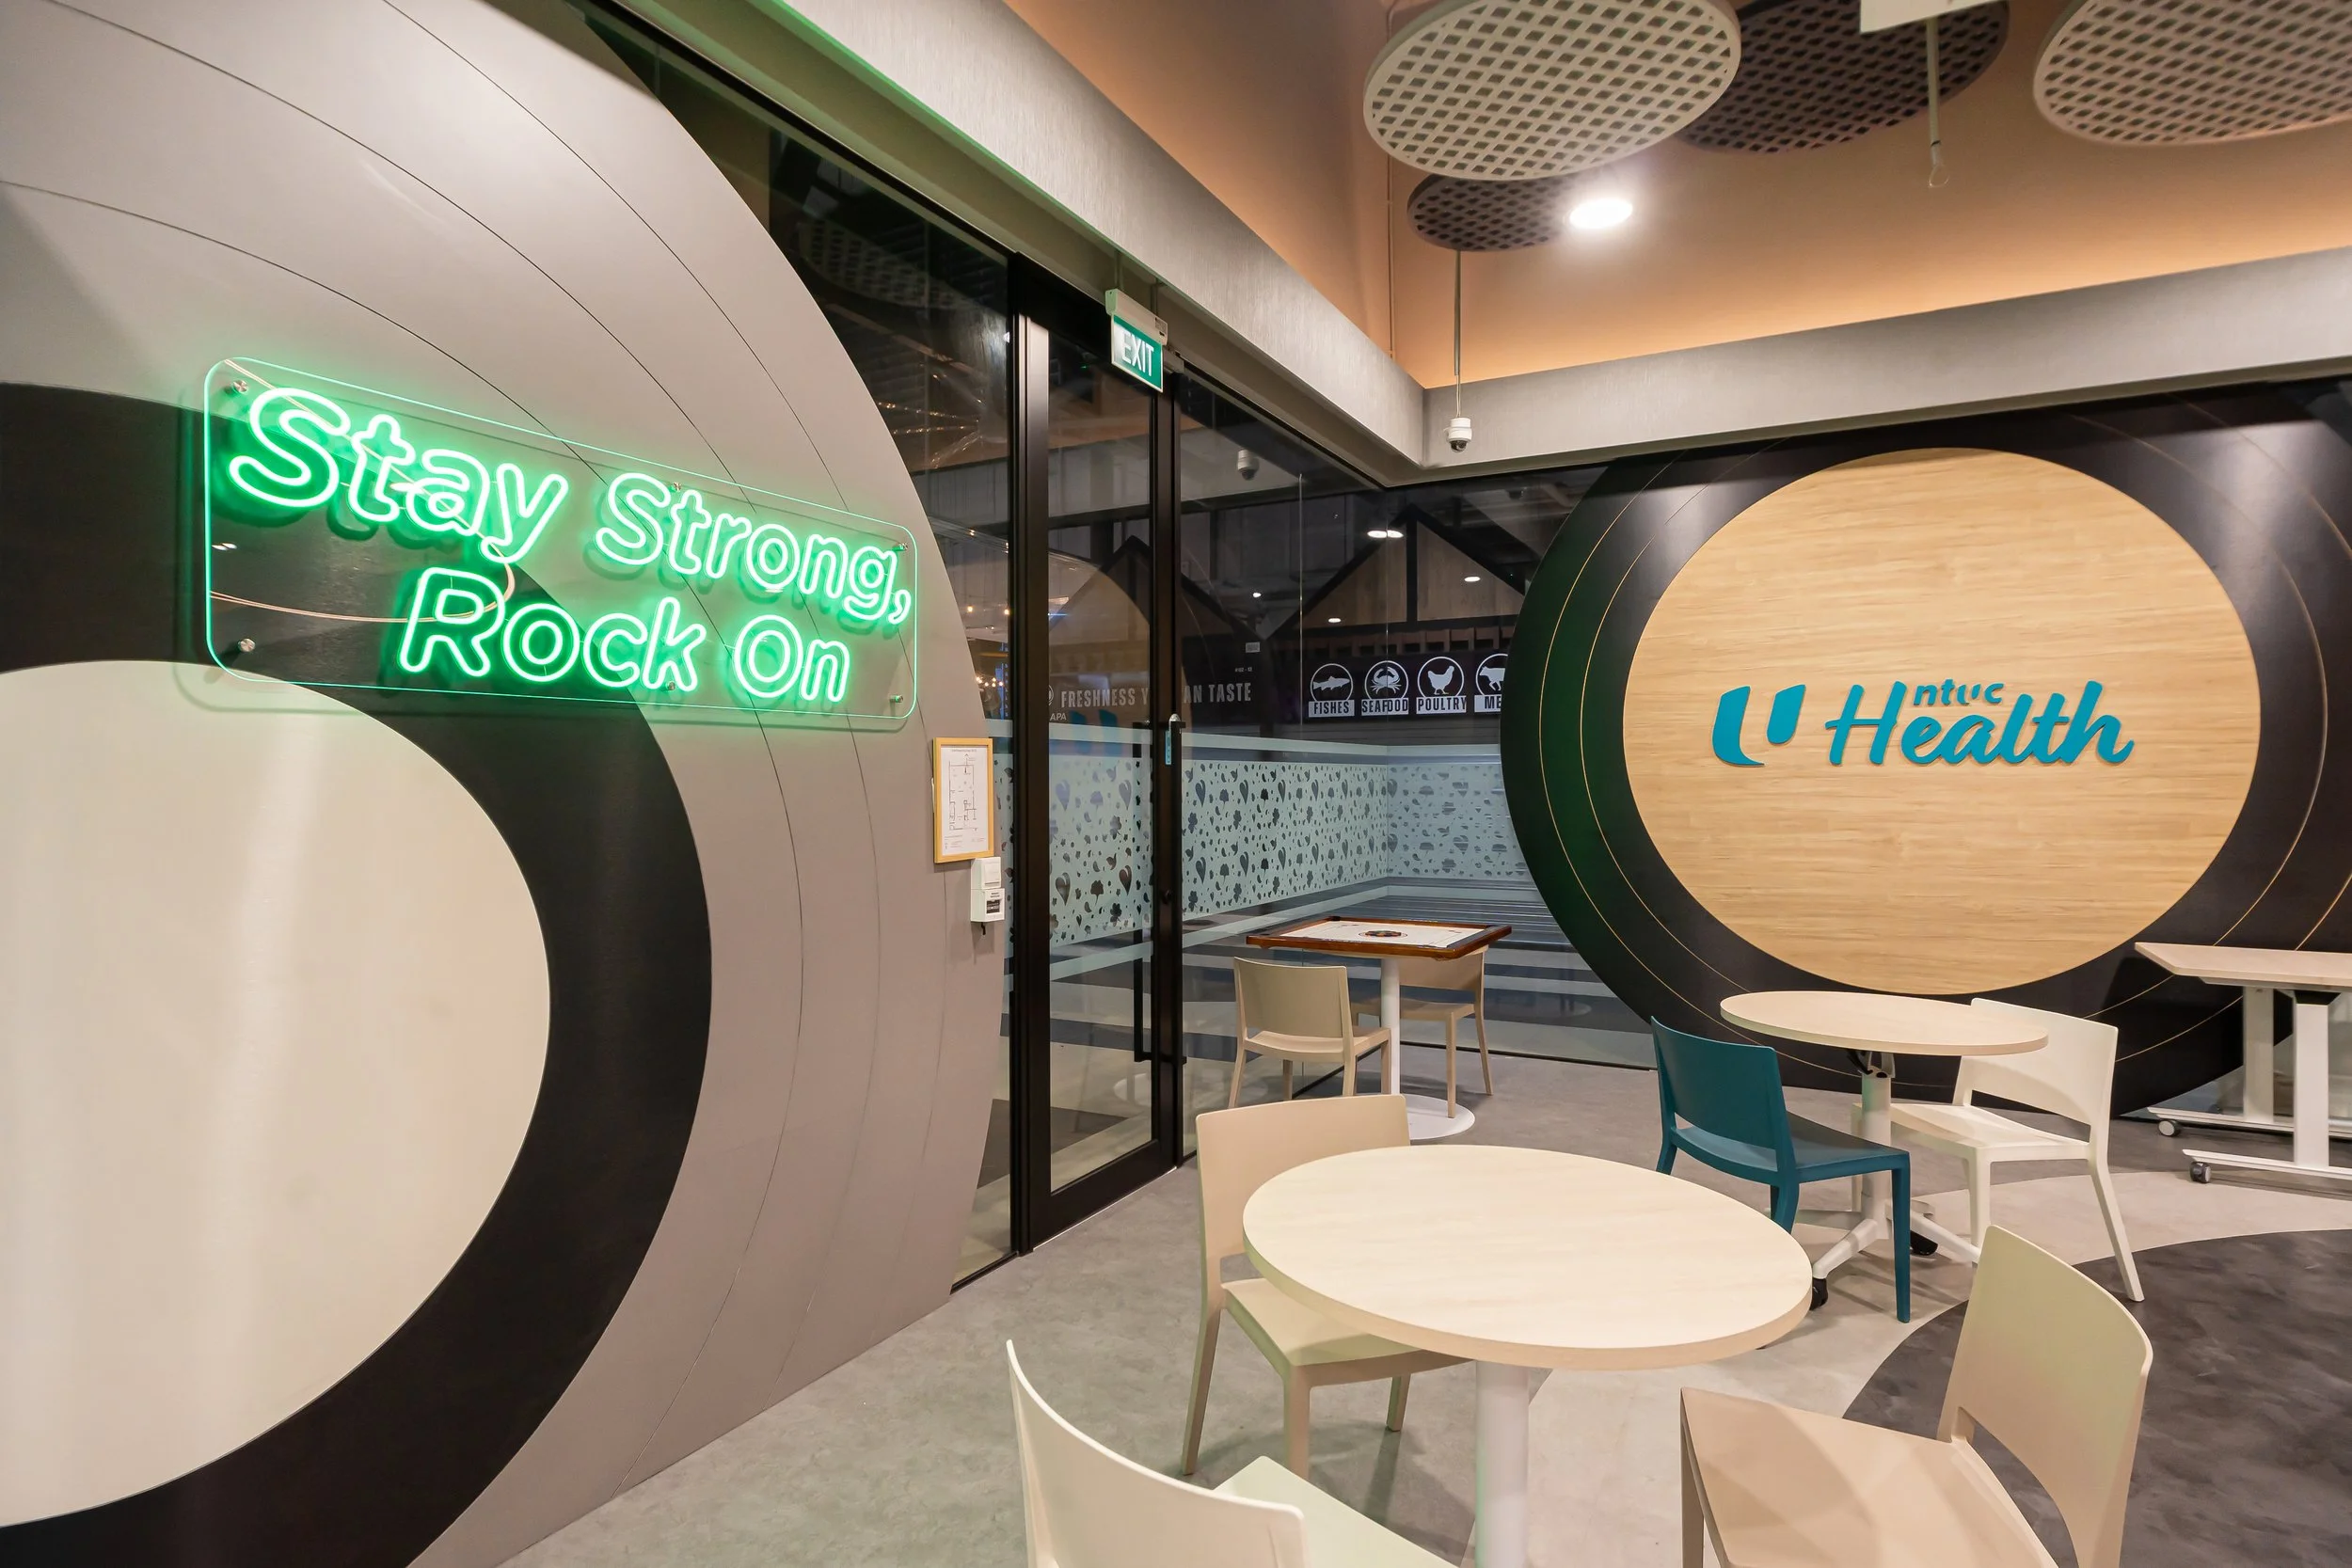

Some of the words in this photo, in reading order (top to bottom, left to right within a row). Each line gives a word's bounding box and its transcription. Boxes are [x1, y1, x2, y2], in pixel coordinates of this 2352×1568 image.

[1121, 328, 1154, 377] EXIT
[229, 387, 568, 562] Stay
[594, 472, 912, 626] Strong,
[398, 566, 707, 693] Rock
[732, 614, 850, 704] On
[1061, 688, 1136, 708] FRESHNESS
[1182, 685, 1202, 704] AN
[1208, 682, 1251, 703] TASTE
[1313, 701, 1350, 715] FISHES
[1361, 699, 1408, 713] SEAFOOD
[1418, 697, 1466, 711] POULTRY
[1485, 696, 1502, 709] ME
[1824, 680, 2135, 765] Health
